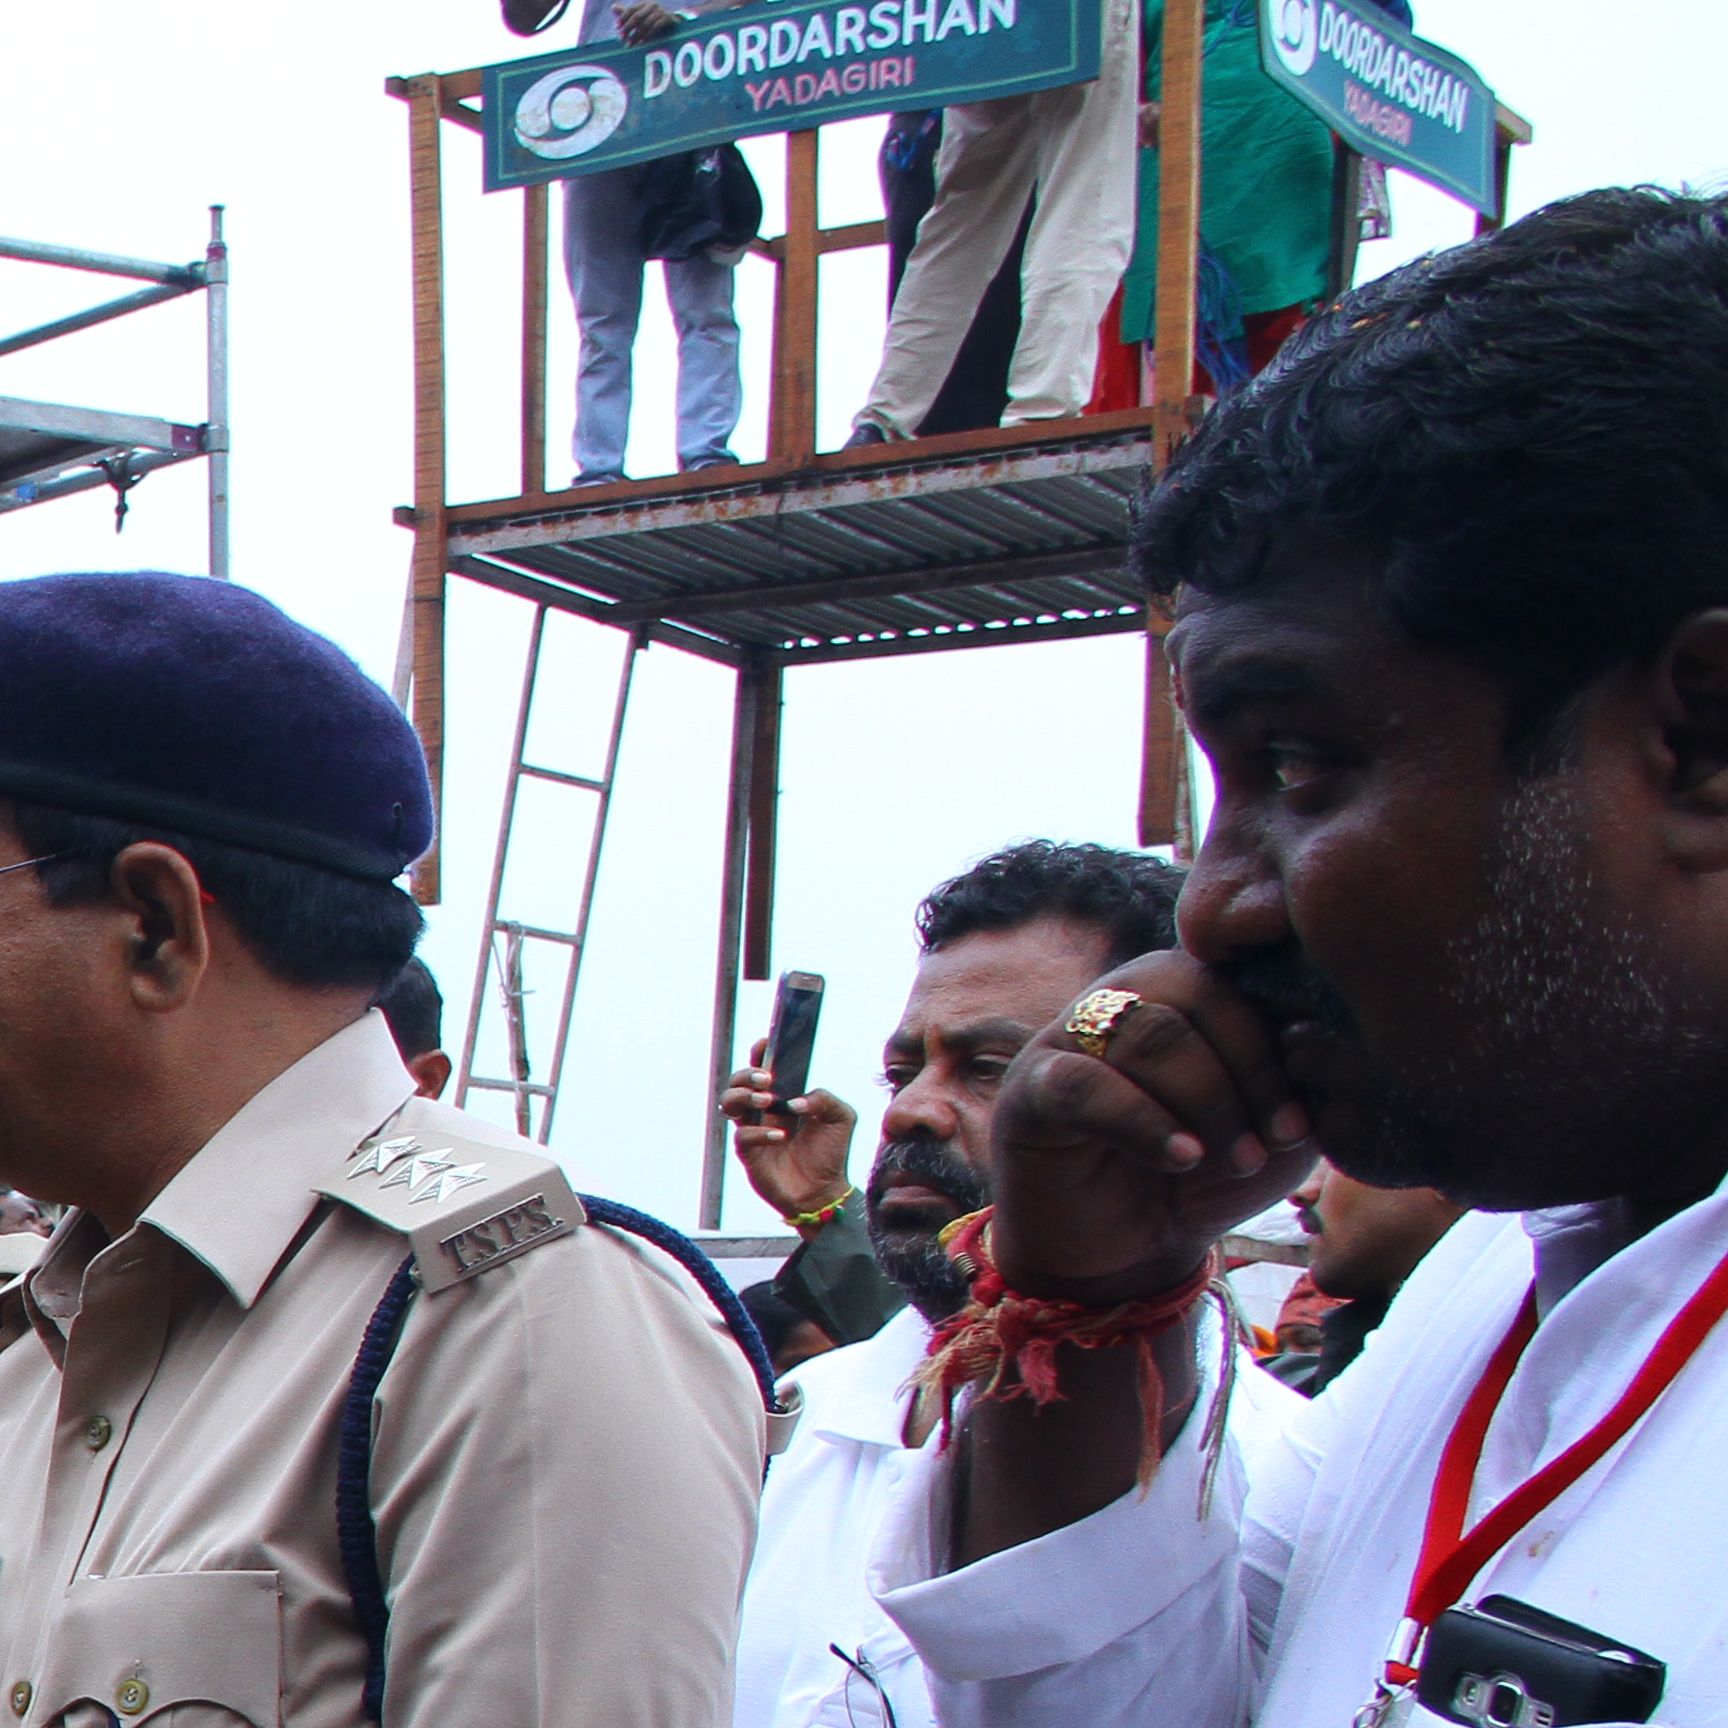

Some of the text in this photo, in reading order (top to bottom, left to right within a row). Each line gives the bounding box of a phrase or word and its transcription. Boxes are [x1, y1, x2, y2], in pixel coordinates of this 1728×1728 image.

[644, 0, 1016, 98] DOORDARSHAN
[745, 55, 915, 112] YADAGIRI
[1319, 1, 1470, 134] DOORDARSHAN
